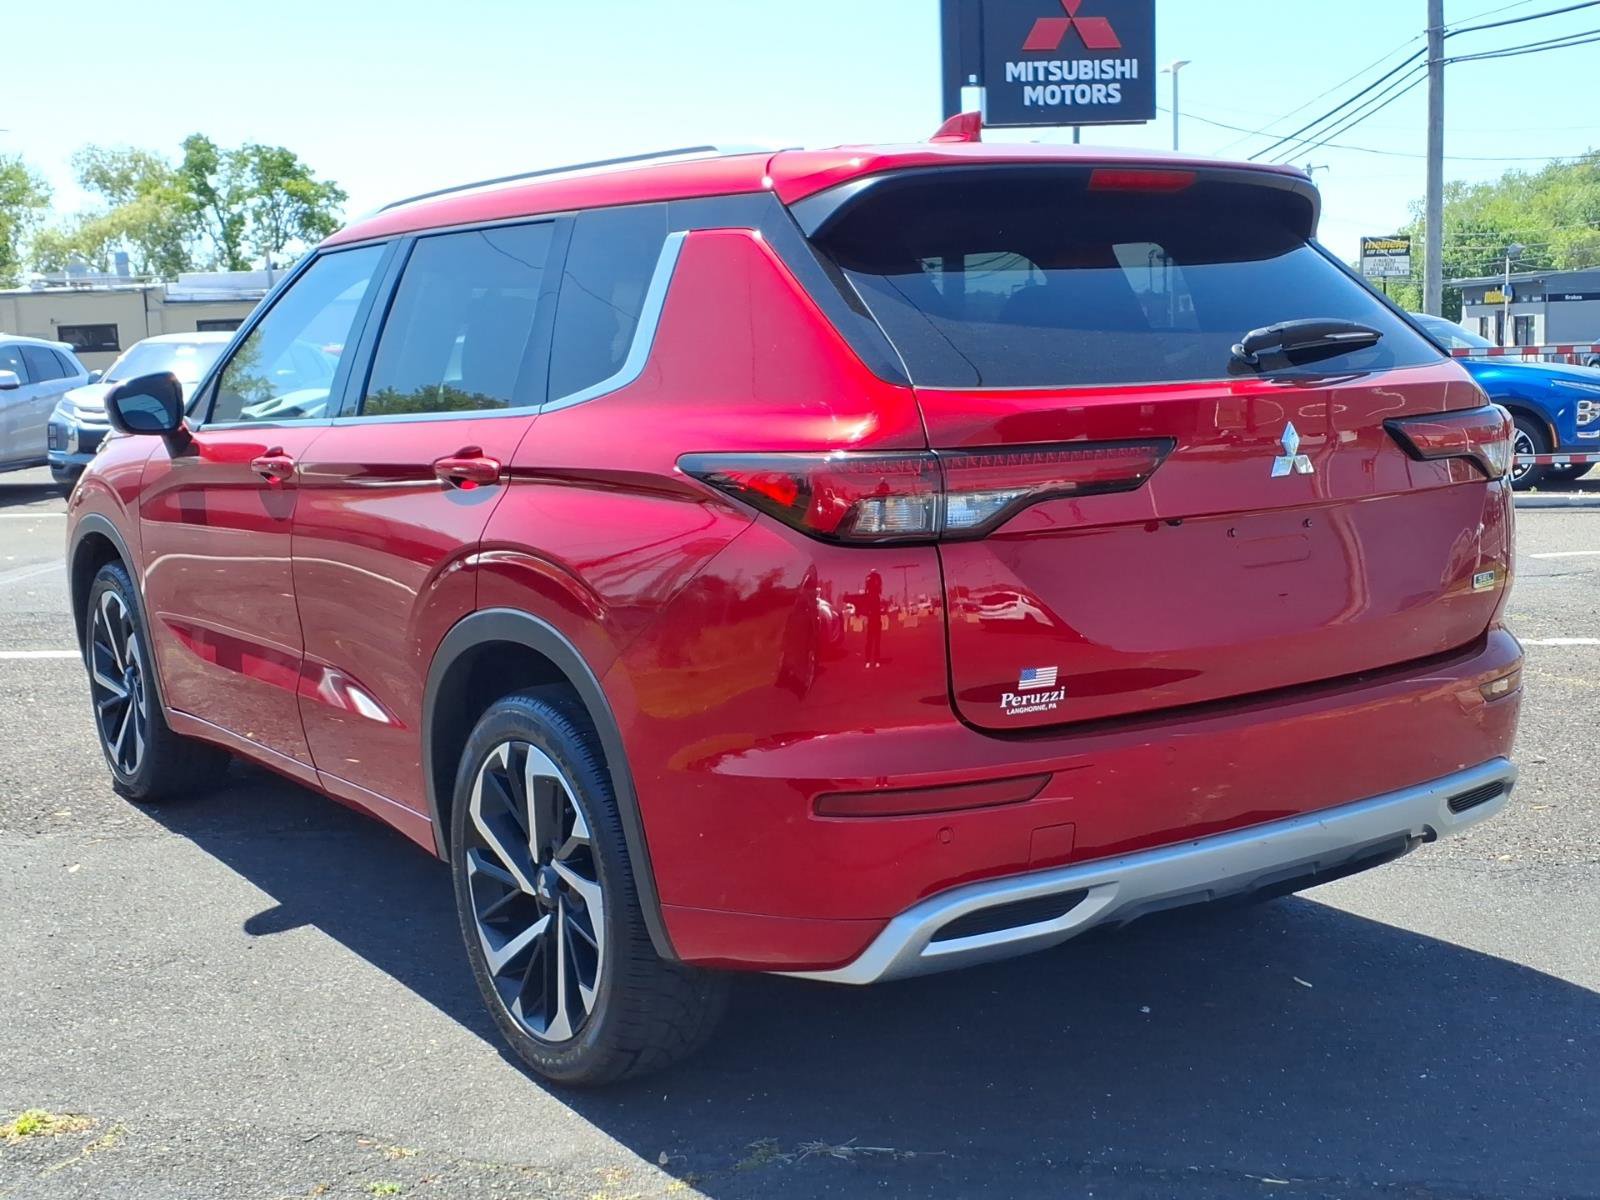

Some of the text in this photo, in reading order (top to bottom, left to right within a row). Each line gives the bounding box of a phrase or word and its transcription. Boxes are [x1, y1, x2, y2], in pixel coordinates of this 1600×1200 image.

[1005, 58, 1138, 82] MITSUBISHI
[1023, 83, 1122, 106] MOTORS
[999, 686, 1066, 708] Peruzzi
[1006, 705, 1048, 715] LANGHORNE,
